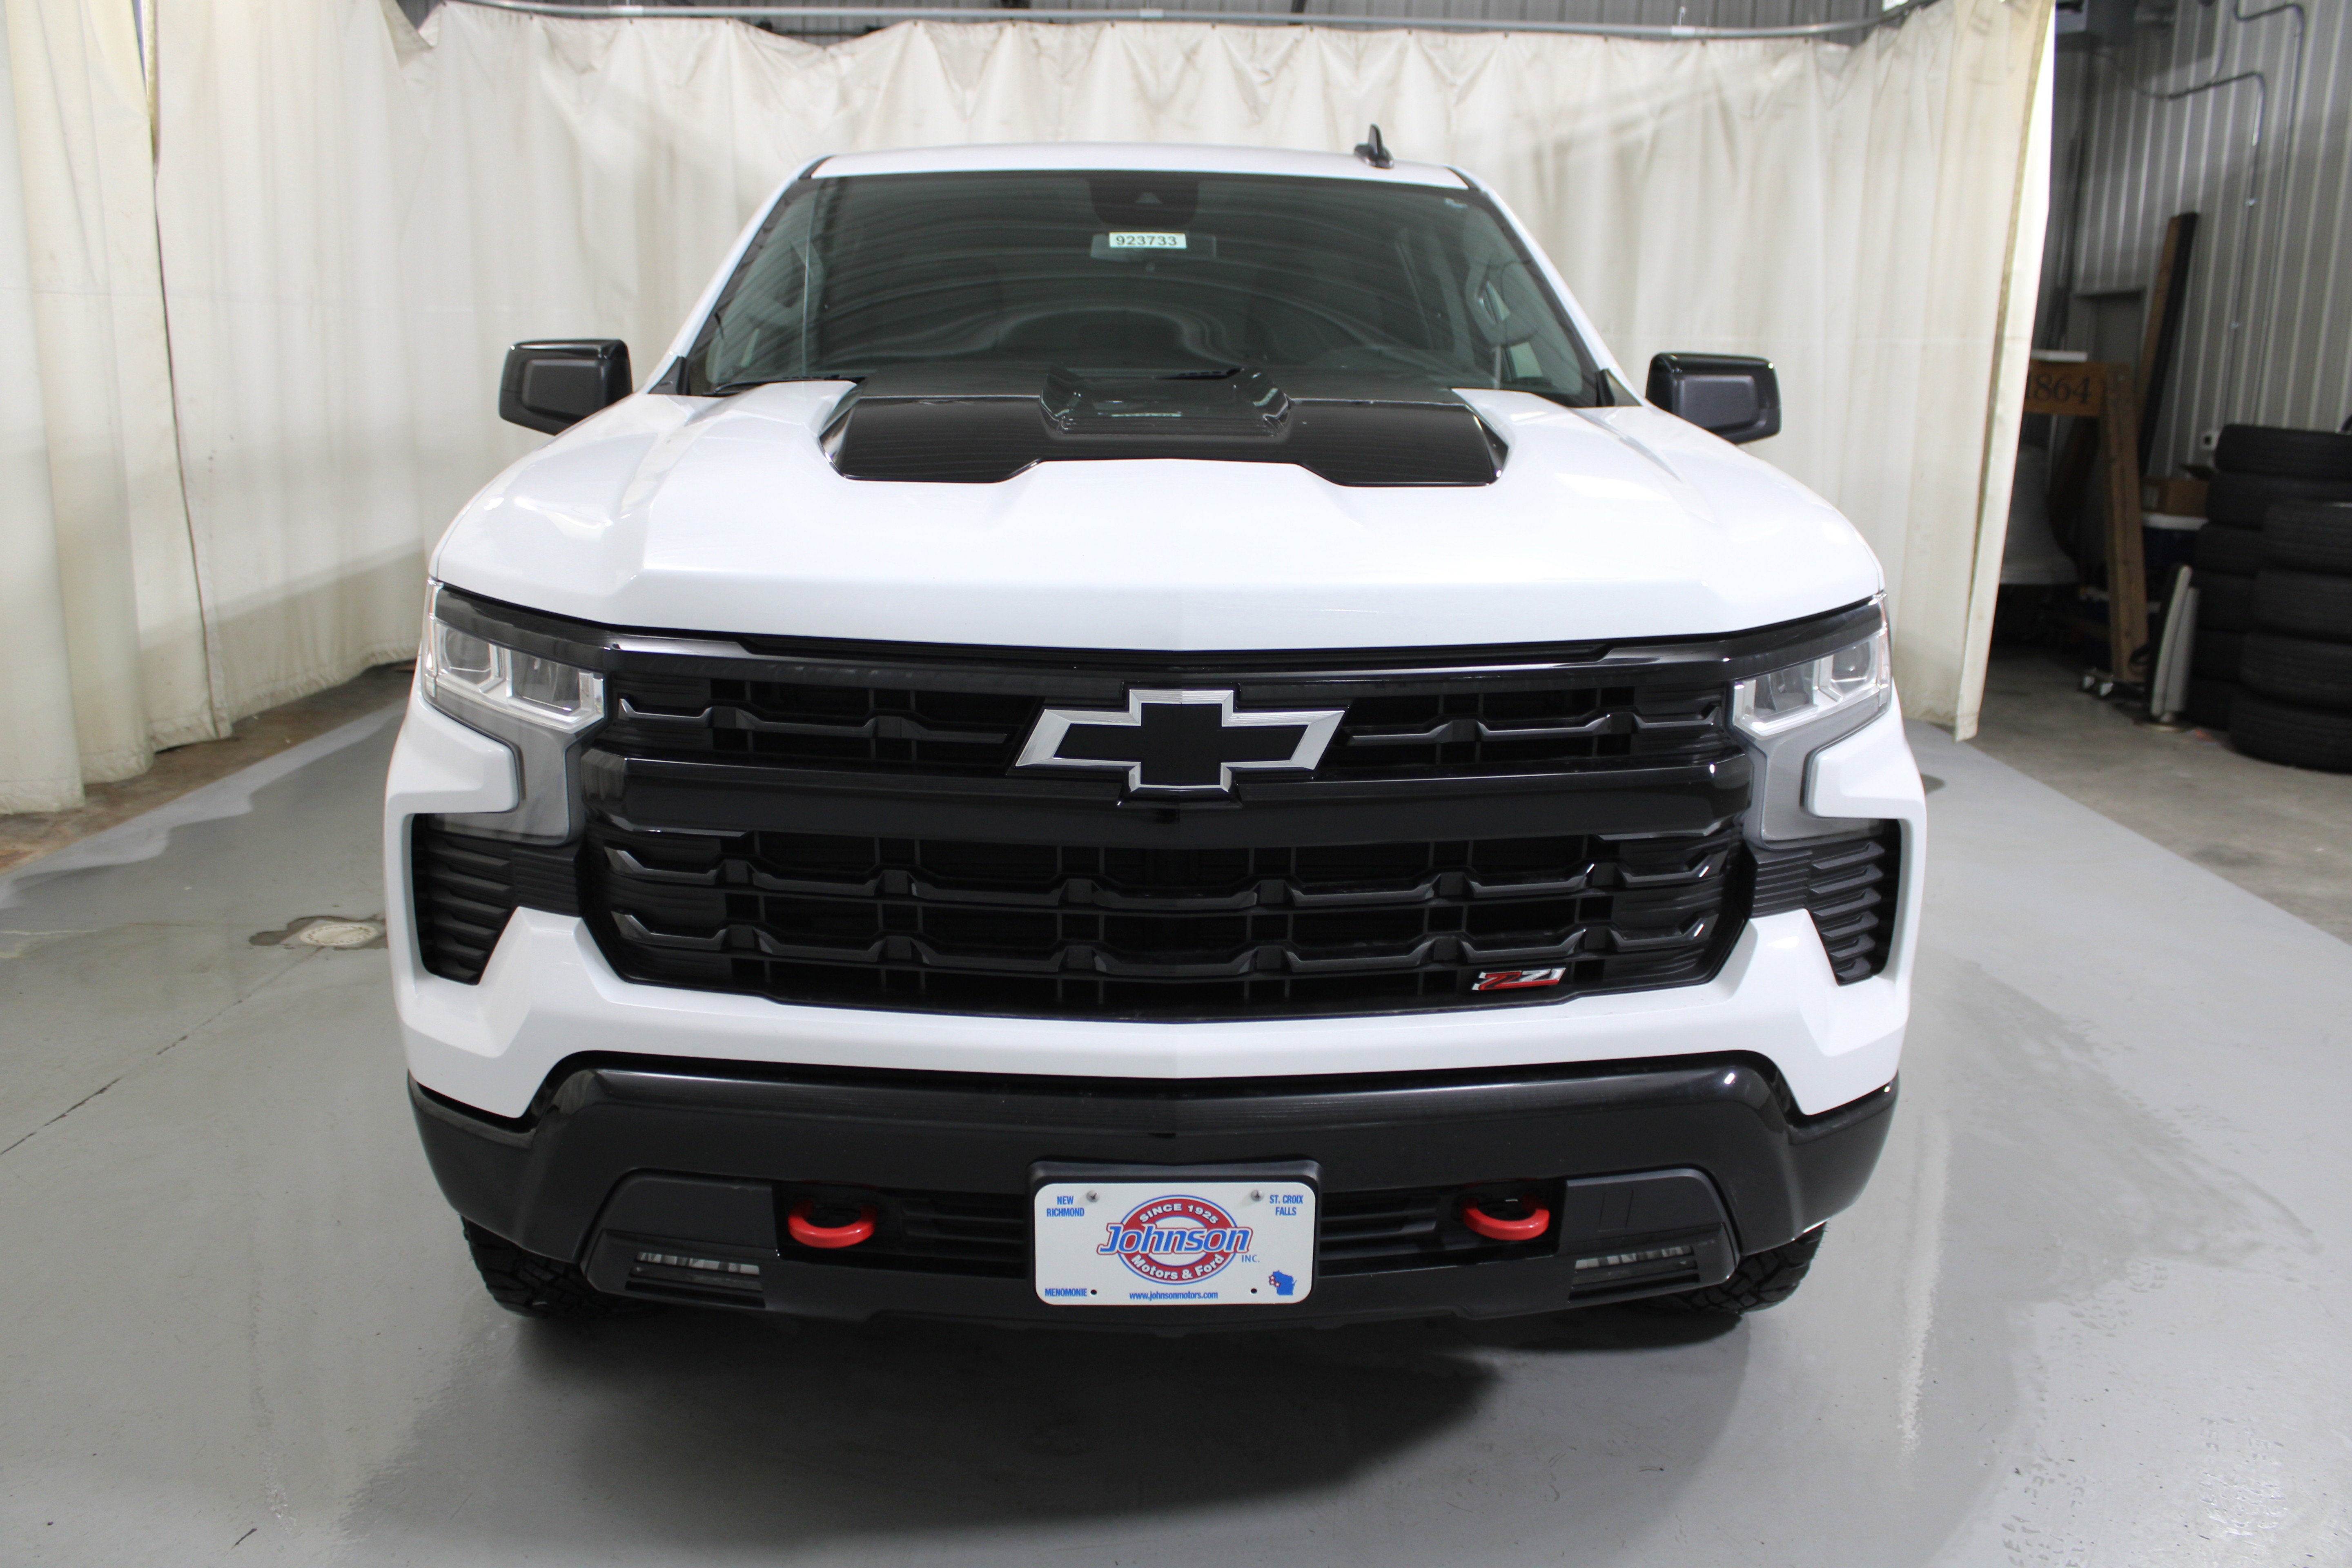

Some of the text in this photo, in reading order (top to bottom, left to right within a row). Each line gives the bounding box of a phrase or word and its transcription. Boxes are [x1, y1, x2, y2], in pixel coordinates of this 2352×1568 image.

[1116, 235, 1177, 245] 923733
[1472, 967, 1566, 991] Z71
[1057, 1196, 1074, 1205] NEW
[1270, 1194, 1303, 1204] ST. CROIX
[1047, 1207, 1085, 1217] RICHMOND
[1139, 1203, 1219, 1225] SINCE 1925
[1275, 1207, 1296, 1216] FALLS
[1098, 1224, 1251, 1254] Johnson
[1241, 1254, 1260, 1263] INC.
[1131, 1253, 1225, 1280] Motors & Ford
[1045, 1288, 1087, 1297] MENOMONIE
[1129, 1291, 1218, 1301] www.johnsonmotors.com
